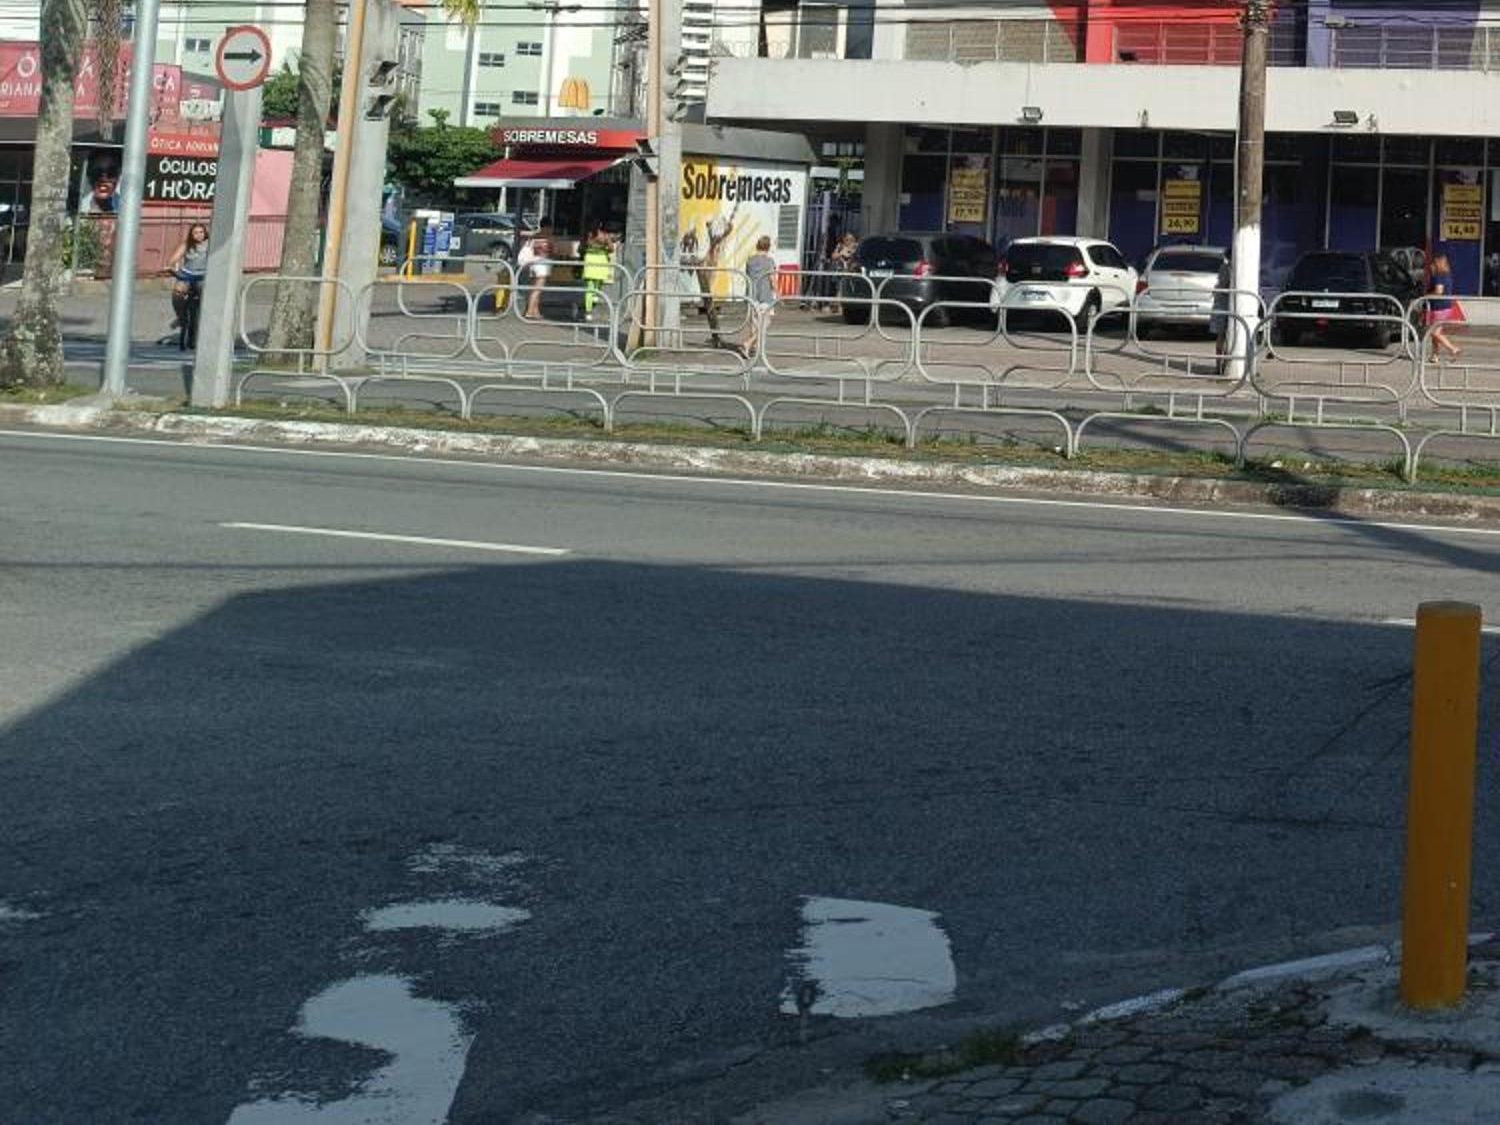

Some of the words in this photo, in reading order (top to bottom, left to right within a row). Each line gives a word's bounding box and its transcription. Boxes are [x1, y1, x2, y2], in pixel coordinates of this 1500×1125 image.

[1, 82, 42, 97] RIANA
[503, 130, 597, 144] SOBREMESAS
[159, 156, 217, 175] ÓCULOS
[682, 162, 792, 204] Sobremesas
